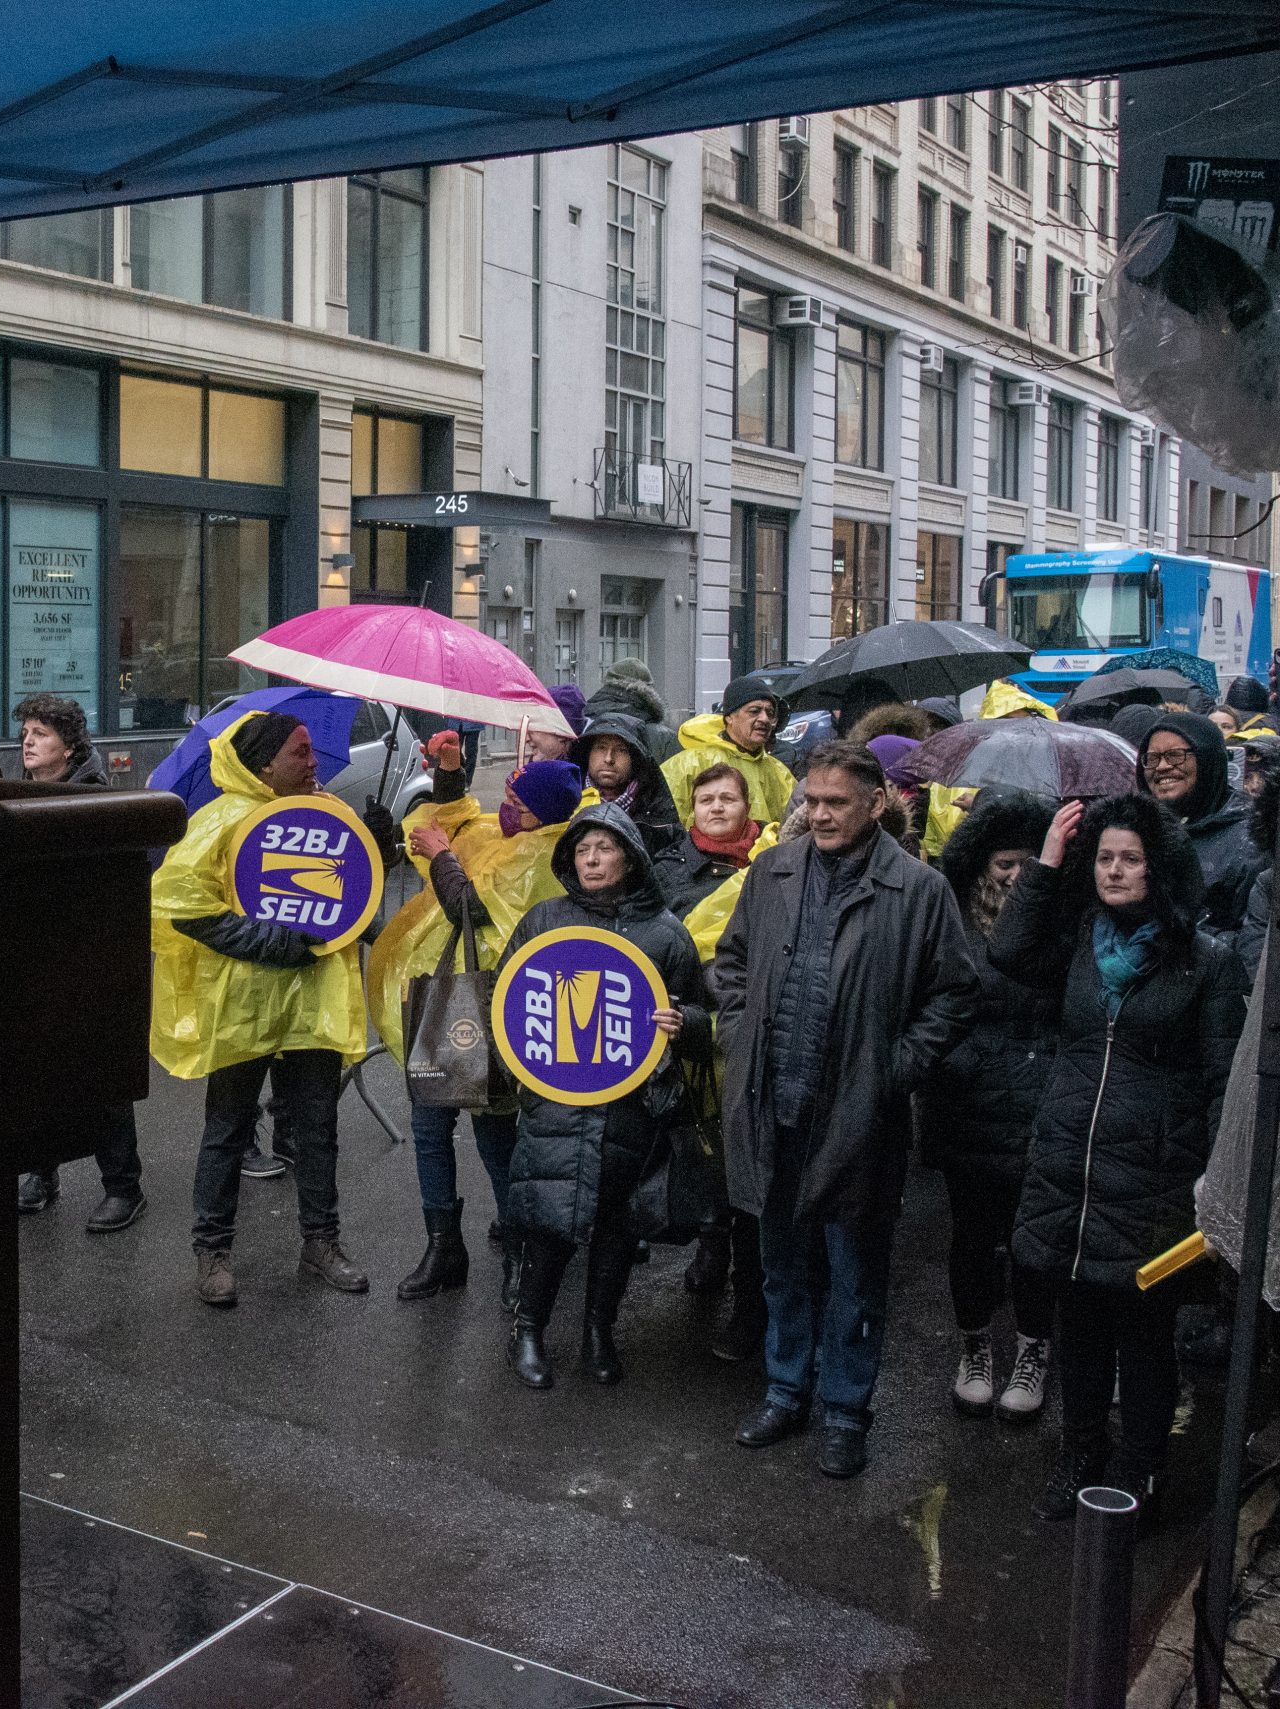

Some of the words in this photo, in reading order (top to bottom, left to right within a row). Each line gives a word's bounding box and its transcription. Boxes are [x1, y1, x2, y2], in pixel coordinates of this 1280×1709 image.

[1211, 168, 1265, 179] MONSTER
[435, 494, 469, 514] 245
[18, 551, 88, 568] EXCELLENT
[1024, 561, 1071, 569] Mammography
[1072, 559, 1106, 567] Screening
[32, 568, 75, 584] RETAIL
[12, 584, 92, 600] OPPORTUNITY
[260, 824, 350, 856] 32BJ
[255, 896, 342, 926] SEIU
[525, 967, 553, 1065] 32BJ
[605, 969, 632, 1067] SEIU
[446, 1029, 485, 1039] SOLGAR
